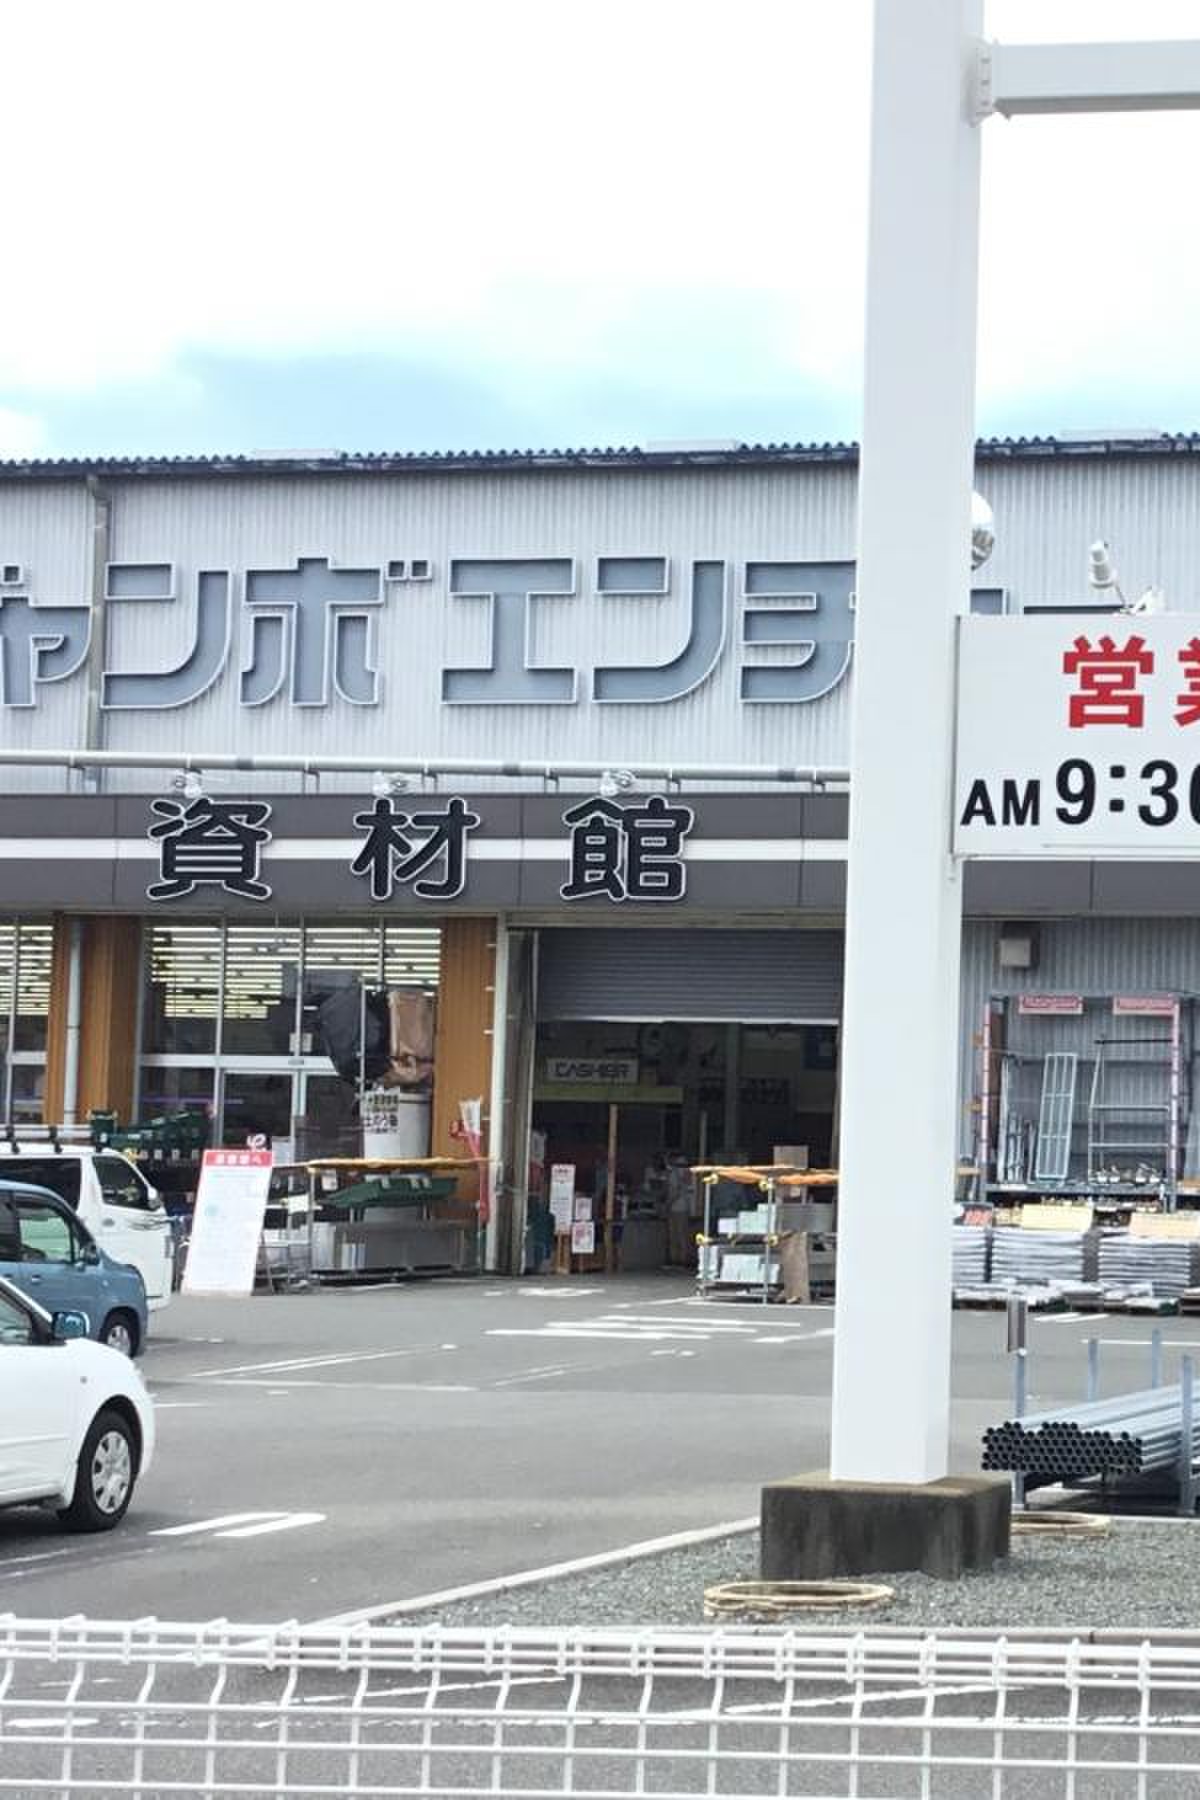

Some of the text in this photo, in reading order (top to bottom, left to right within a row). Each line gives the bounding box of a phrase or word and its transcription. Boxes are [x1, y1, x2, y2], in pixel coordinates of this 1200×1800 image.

[0, 557, 857, 709] ャンボエンチ
[146, 796, 694, 901] 資材館
[959, 778, 1041, 826] AM
